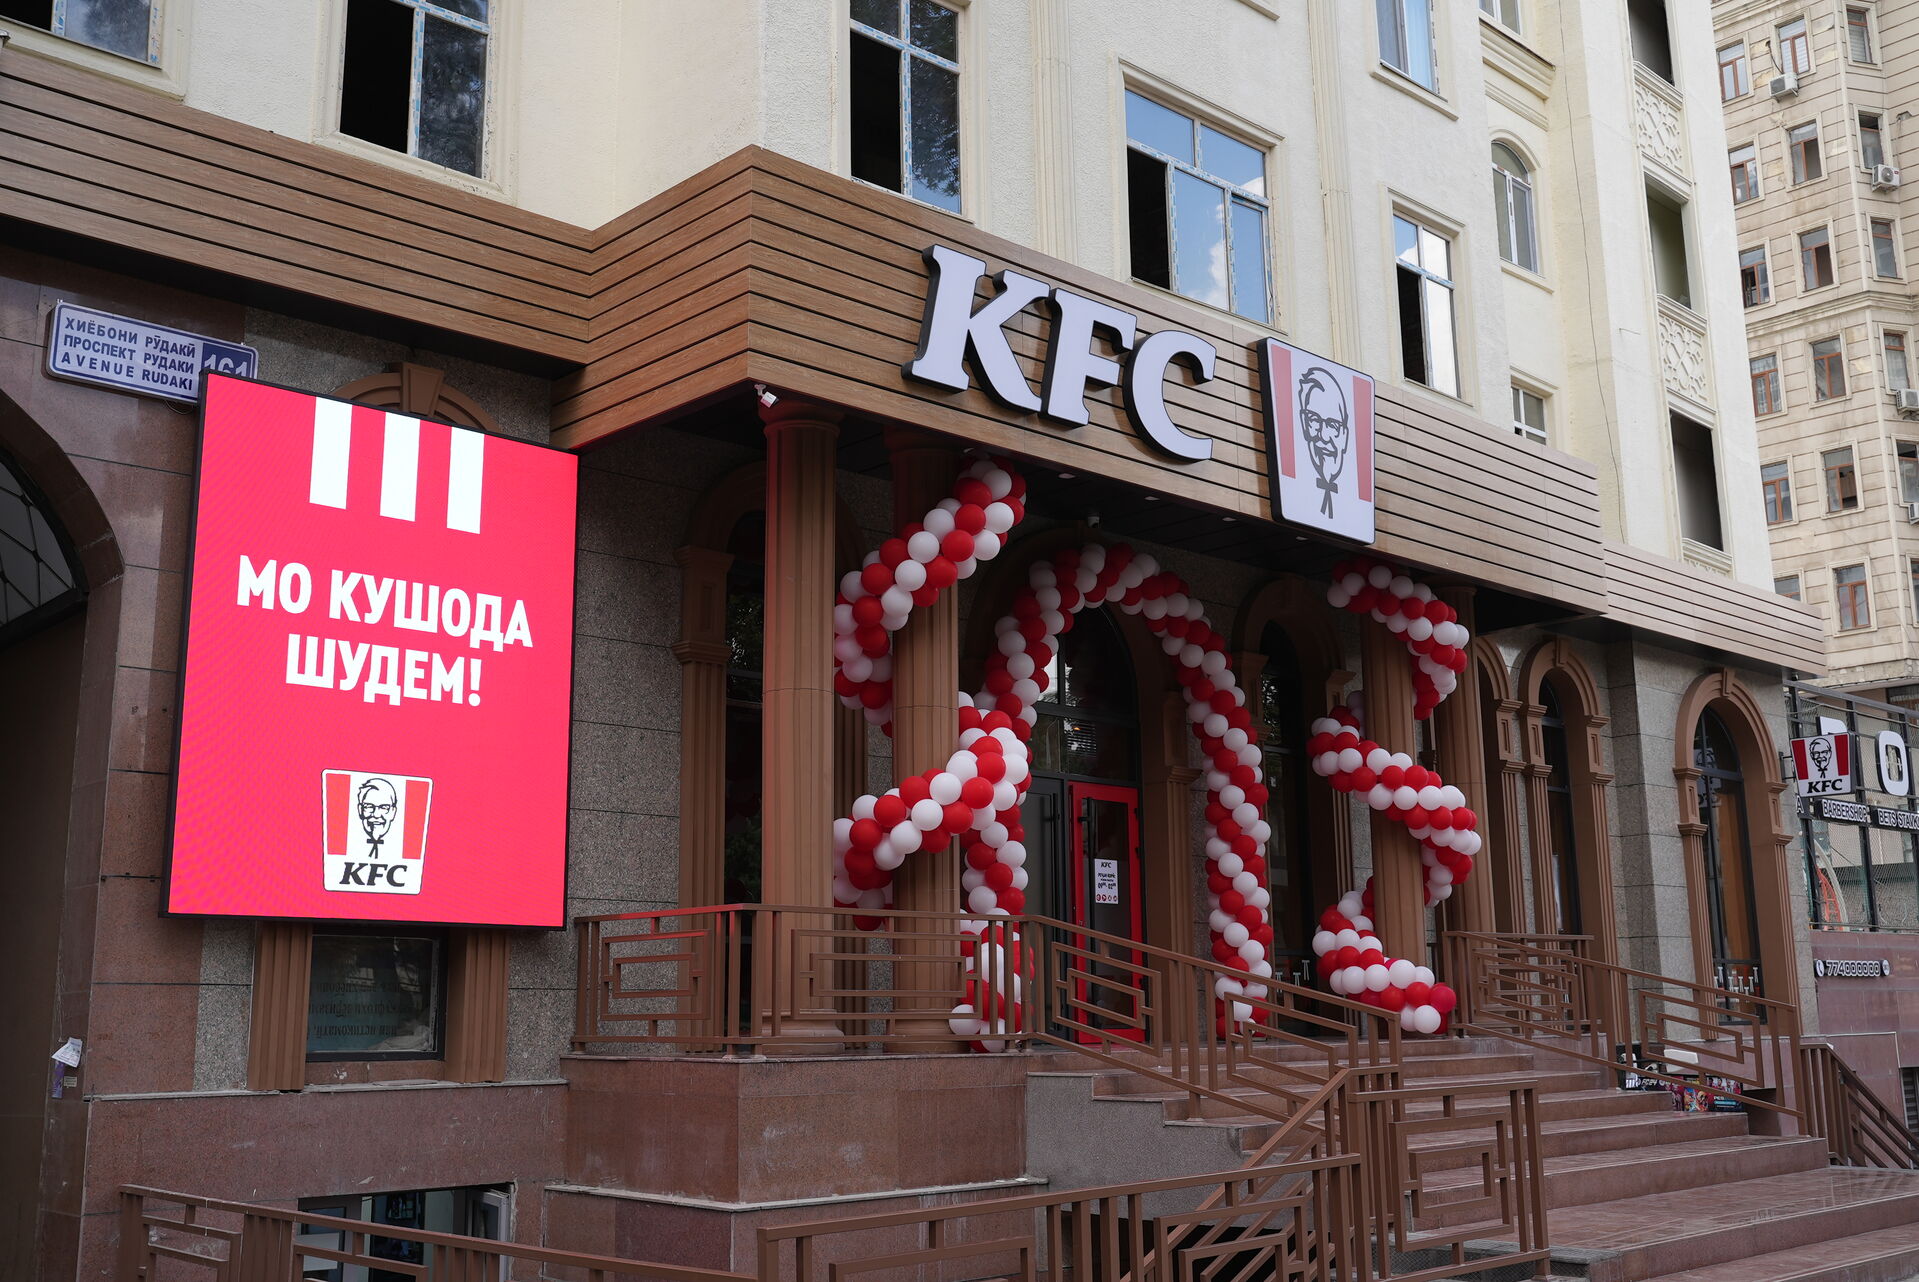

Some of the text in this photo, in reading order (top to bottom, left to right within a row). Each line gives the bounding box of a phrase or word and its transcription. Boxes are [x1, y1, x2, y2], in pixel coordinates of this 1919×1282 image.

[65, 317, 138, 345] ХИЁБОНИ
[61, 352, 193, 391] AVENUE RUDAKI
[63, 334, 194, 375] ПРОСПЕКТ РУДАКИ
[902, 244, 1217, 463] KFC
[236, 555, 534, 653] МО КУШОДА
[285, 633, 482, 707] ШУДЕМ!
[1807, 779, 1843, 793] KFC
[1822, 799, 1868, 823] BARBERSHOP
[339, 862, 408, 888] KFC
